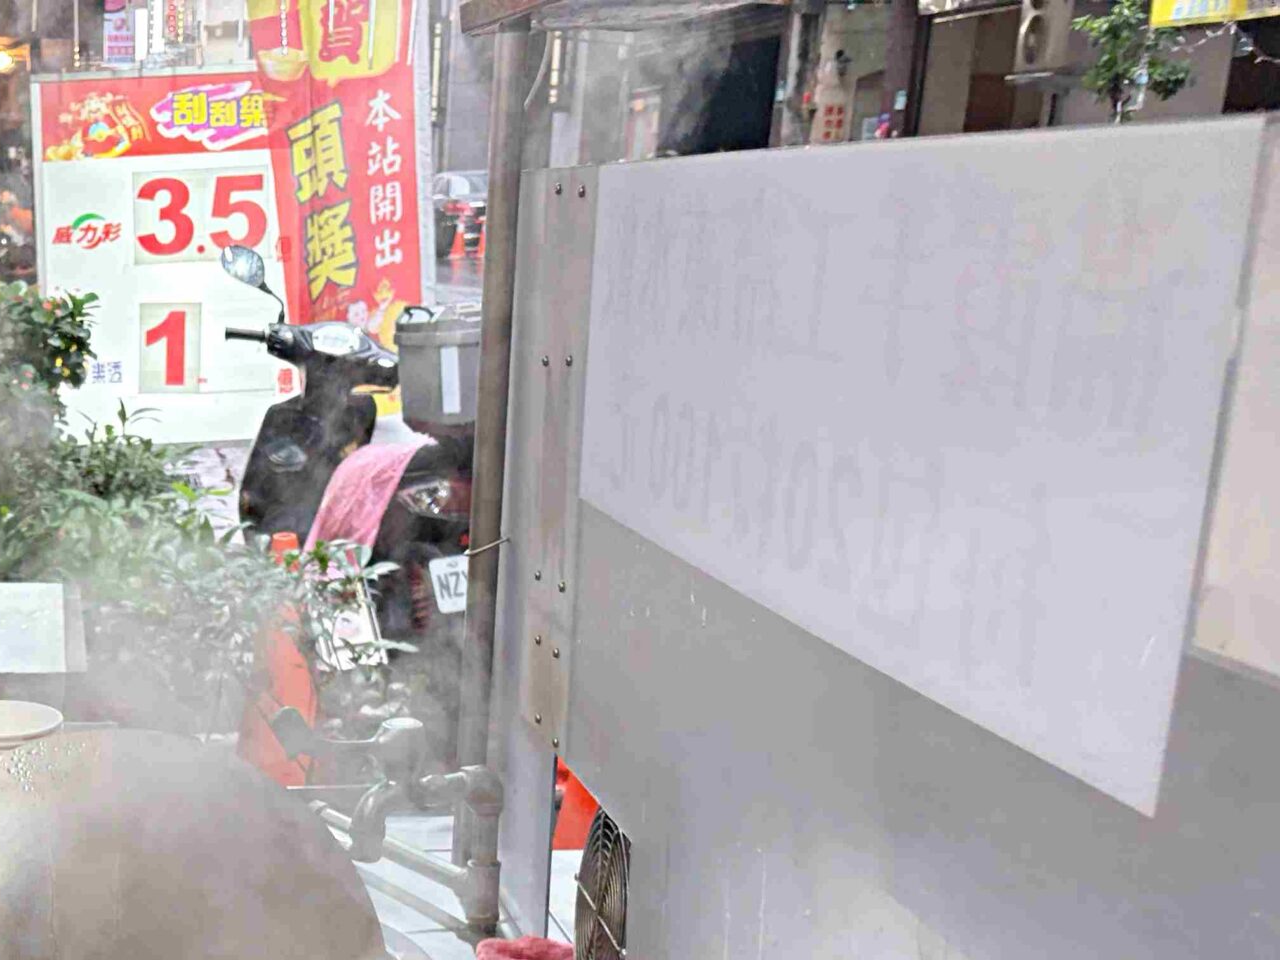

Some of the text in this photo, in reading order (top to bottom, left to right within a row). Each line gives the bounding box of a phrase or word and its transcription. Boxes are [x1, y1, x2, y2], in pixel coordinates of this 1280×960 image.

[172, 91, 267, 128] 刮刮樂
[51, 220, 122, 247] 威力彩
[136, 174, 268, 256] 3.5
[285, 100, 358, 301] 頭獎
[365, 88, 403, 269] 本站開出
[146, 311, 186, 386] 1
